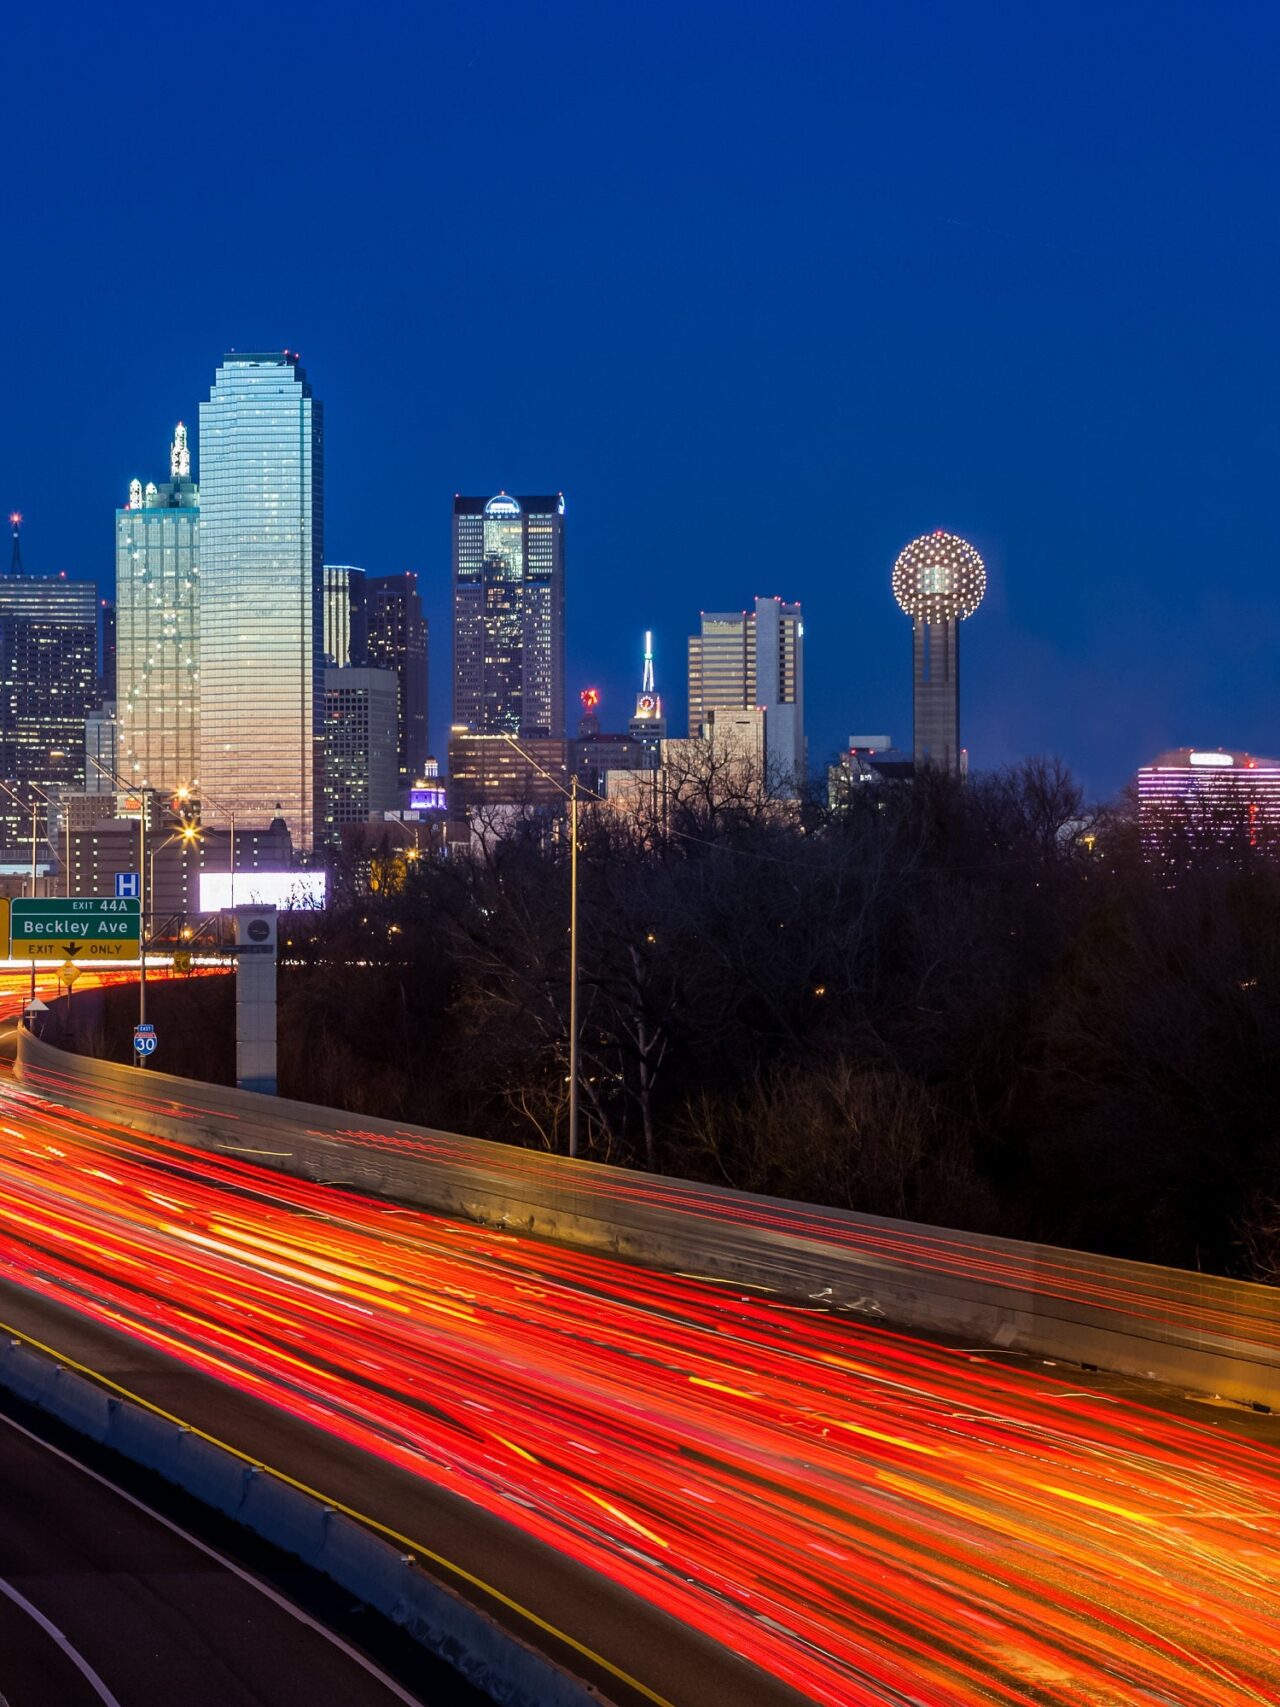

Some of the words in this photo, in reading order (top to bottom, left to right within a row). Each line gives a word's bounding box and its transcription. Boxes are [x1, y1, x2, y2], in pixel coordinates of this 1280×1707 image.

[118, 874, 136, 896] H
[72, 901, 94, 910] EXIT
[100, 900, 128, 912] 44A
[23, 920, 89, 936] Beckley
[98, 920, 128, 933] Ave
[28, 945, 55, 954] EXIT
[90, 945, 122, 954] ONLY
[136, 1038, 155, 1051] 30
